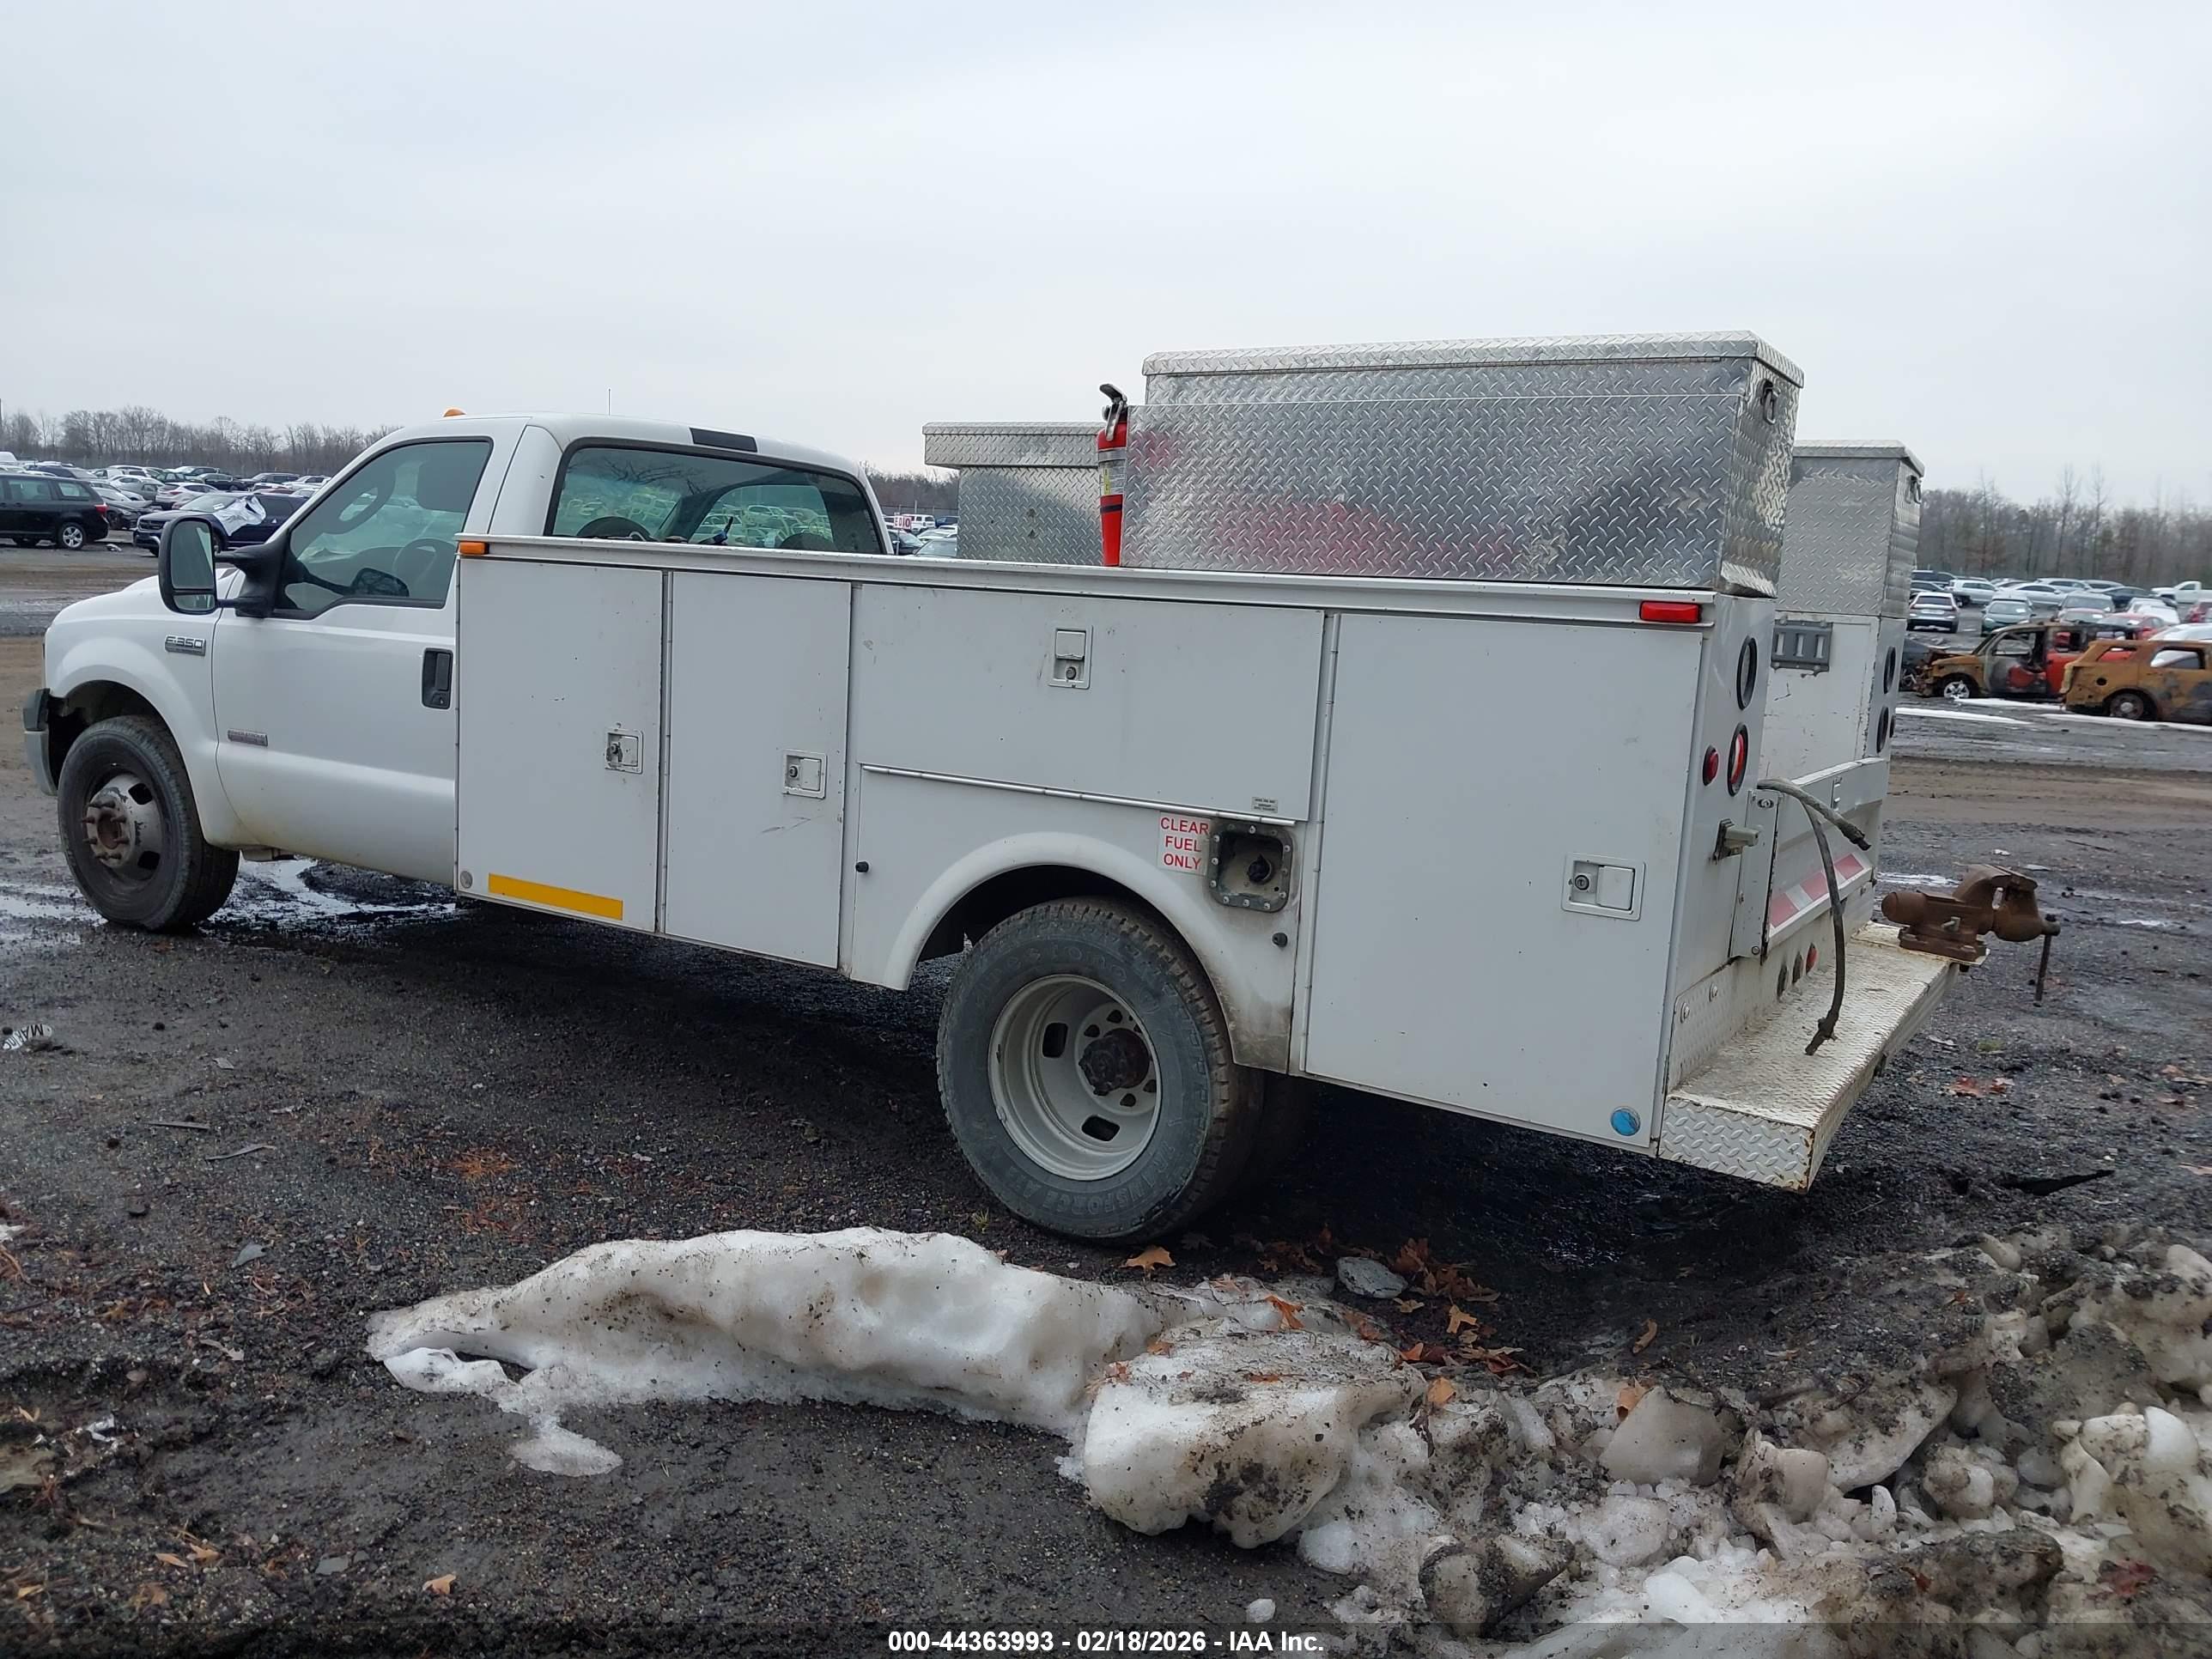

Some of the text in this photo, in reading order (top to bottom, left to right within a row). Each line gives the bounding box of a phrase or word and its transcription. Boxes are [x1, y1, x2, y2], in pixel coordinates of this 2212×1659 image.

[1161, 817, 1209, 836] CLEAR
[1165, 835, 1201, 853] FUEL
[1164, 853, 1201, 870] ONLY
